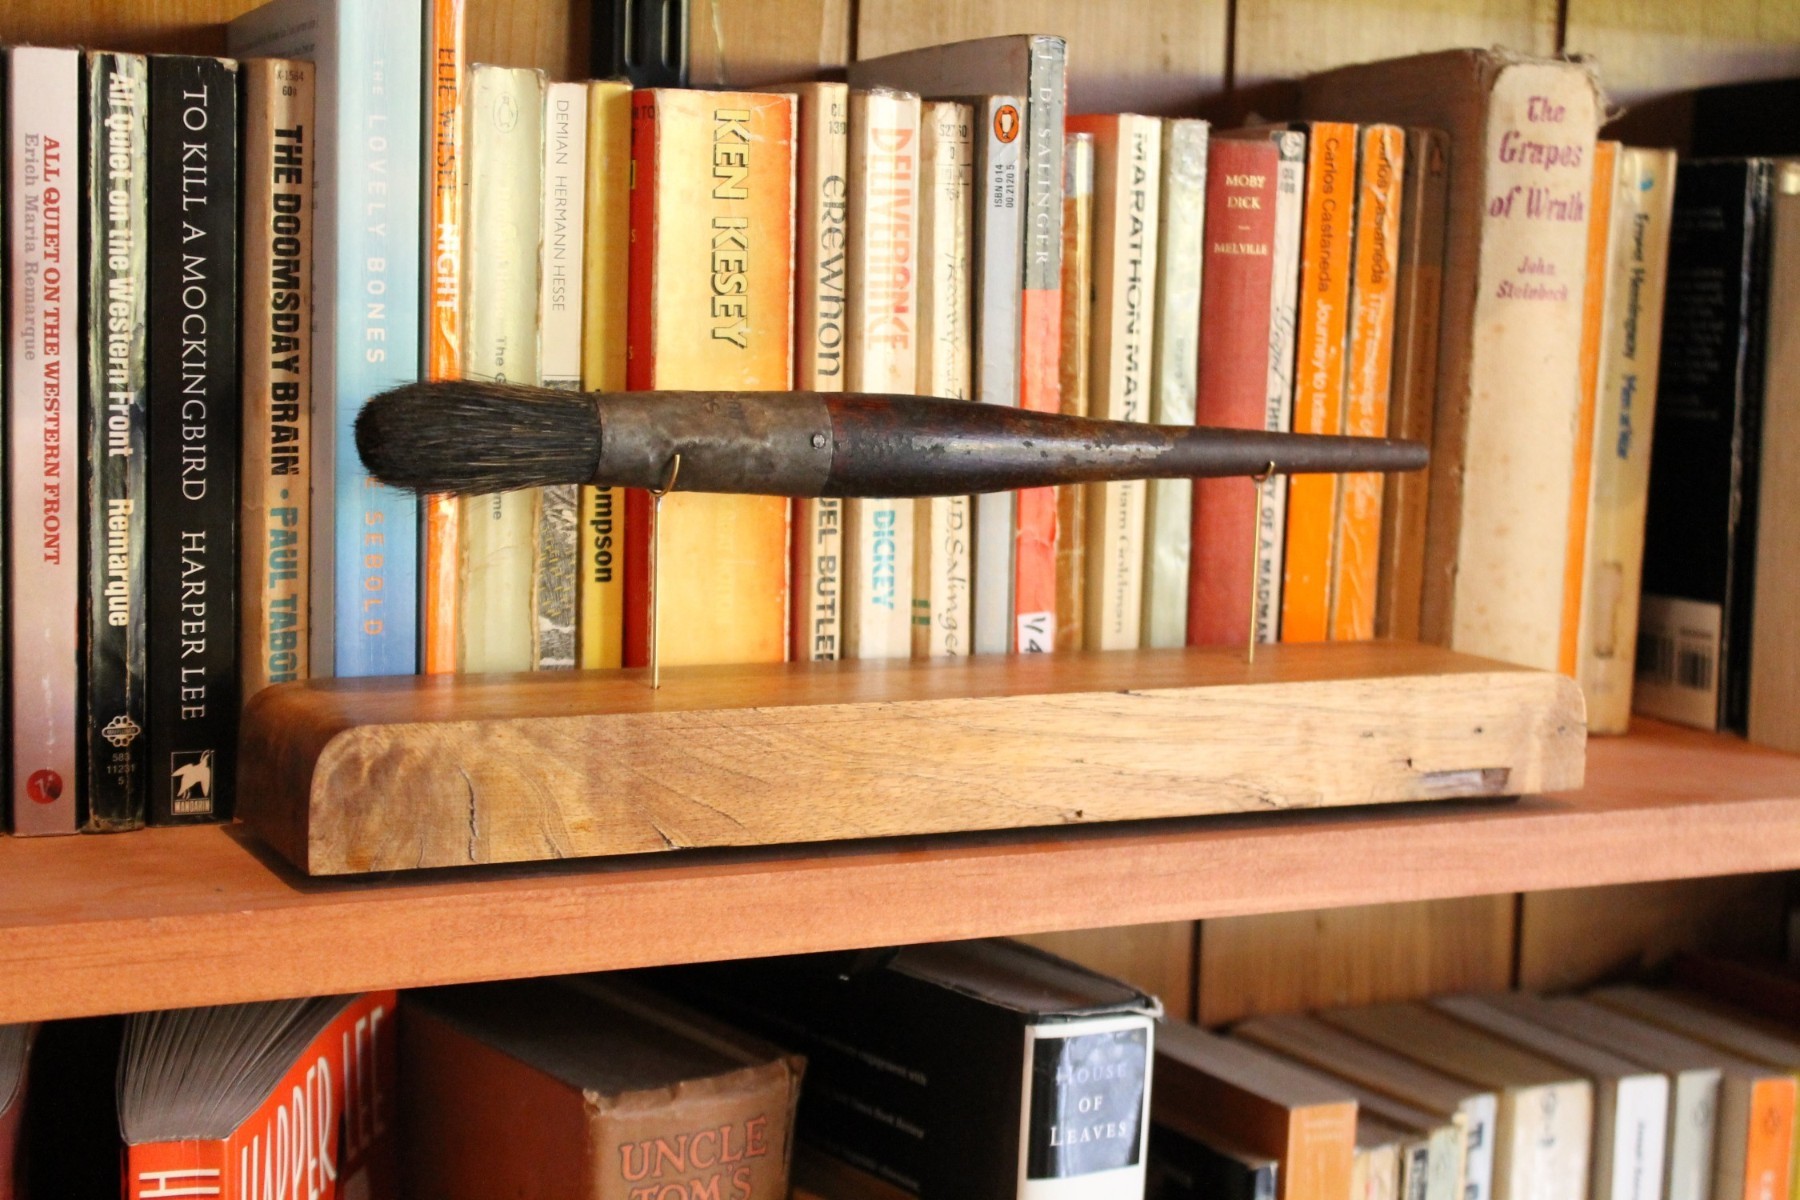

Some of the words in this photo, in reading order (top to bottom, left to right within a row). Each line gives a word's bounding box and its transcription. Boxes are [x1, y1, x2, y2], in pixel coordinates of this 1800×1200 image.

[109, 73, 135, 111] All
[372, 59, 384, 95] THE
[438, 48, 456, 98] ELIE
[184, 86, 208, 131] TO
[556, 100, 569, 165] DEMIAN
[1527, 96, 1566, 123] The
[24, 133, 39, 187] Erich
[43, 137, 61, 181] ALL
[104, 115, 135, 181] Quiet
[184, 143, 208, 211] KILL
[274, 125, 303, 184] THE
[367, 114, 387, 237] LOVELY
[437, 109, 456, 197] WIESEL
[712, 108, 750, 200] KEN
[1323, 138, 1339, 195] Carlos
[1499, 130, 1584, 171] Grapes
[108, 187, 134, 222] on
[994, 186, 1003, 207] ISBN
[1036, 128, 1051, 264] SALINGER
[1225, 174, 1266, 189] MOBY
[1227, 196, 1261, 210] DICK
[1489, 185, 1522, 219] of
[1526, 185, 1585, 222] Wrath
[24, 195, 38, 253] Maria
[43, 187, 61, 262] QUIET
[183, 222, 208, 243] A
[553, 176, 567, 260] HERMANN
[868, 128, 913, 350] DELIVERANCE
[1126, 133, 1148, 335] MARATHON
[1214, 242, 1268, 256] MELVILLE
[1318, 200, 1337, 292] Castaneda
[108, 230, 134, 270] the
[437, 223, 459, 312] NIGHT
[1517, 256, 1556, 275] John
[23, 262, 37, 361] Remarque
[44, 266, 61, 300] ON
[272, 194, 302, 376] DOOMSDAY
[366, 256, 386, 363] BONES
[552, 265, 565, 311] HESSE
[711, 216, 748, 349] KESEY
[44, 307, 61, 356] THE
[108, 276, 135, 385] Western
[1312, 299, 1334, 369] Journey
[182, 257, 208, 500] MOCKINGBIRD
[1313, 371, 1328, 390] to
[44, 359, 61, 477] WESTERN
[107, 391, 135, 456] Front
[270, 383, 299, 475] BRAIN
[1268, 397, 1282, 432] THE
[44, 484, 61, 564] FRONT
[269, 507, 299, 588] PAUL
[1262, 507, 1274, 530] OF
[103, 498, 134, 627] Remarque
[364, 512, 384, 636] SEBOLD
[872, 510, 896, 610] DICKEY
[181, 531, 206, 659] HARPER
[181, 667, 205, 720] LEE
[1055, 1061, 1128, 1087] HOUSE
[1050, 1122, 1128, 1147] LEAVES
[1078, 1097, 1104, 1114] OF
[620, 1113, 767, 1182] UNCLE
